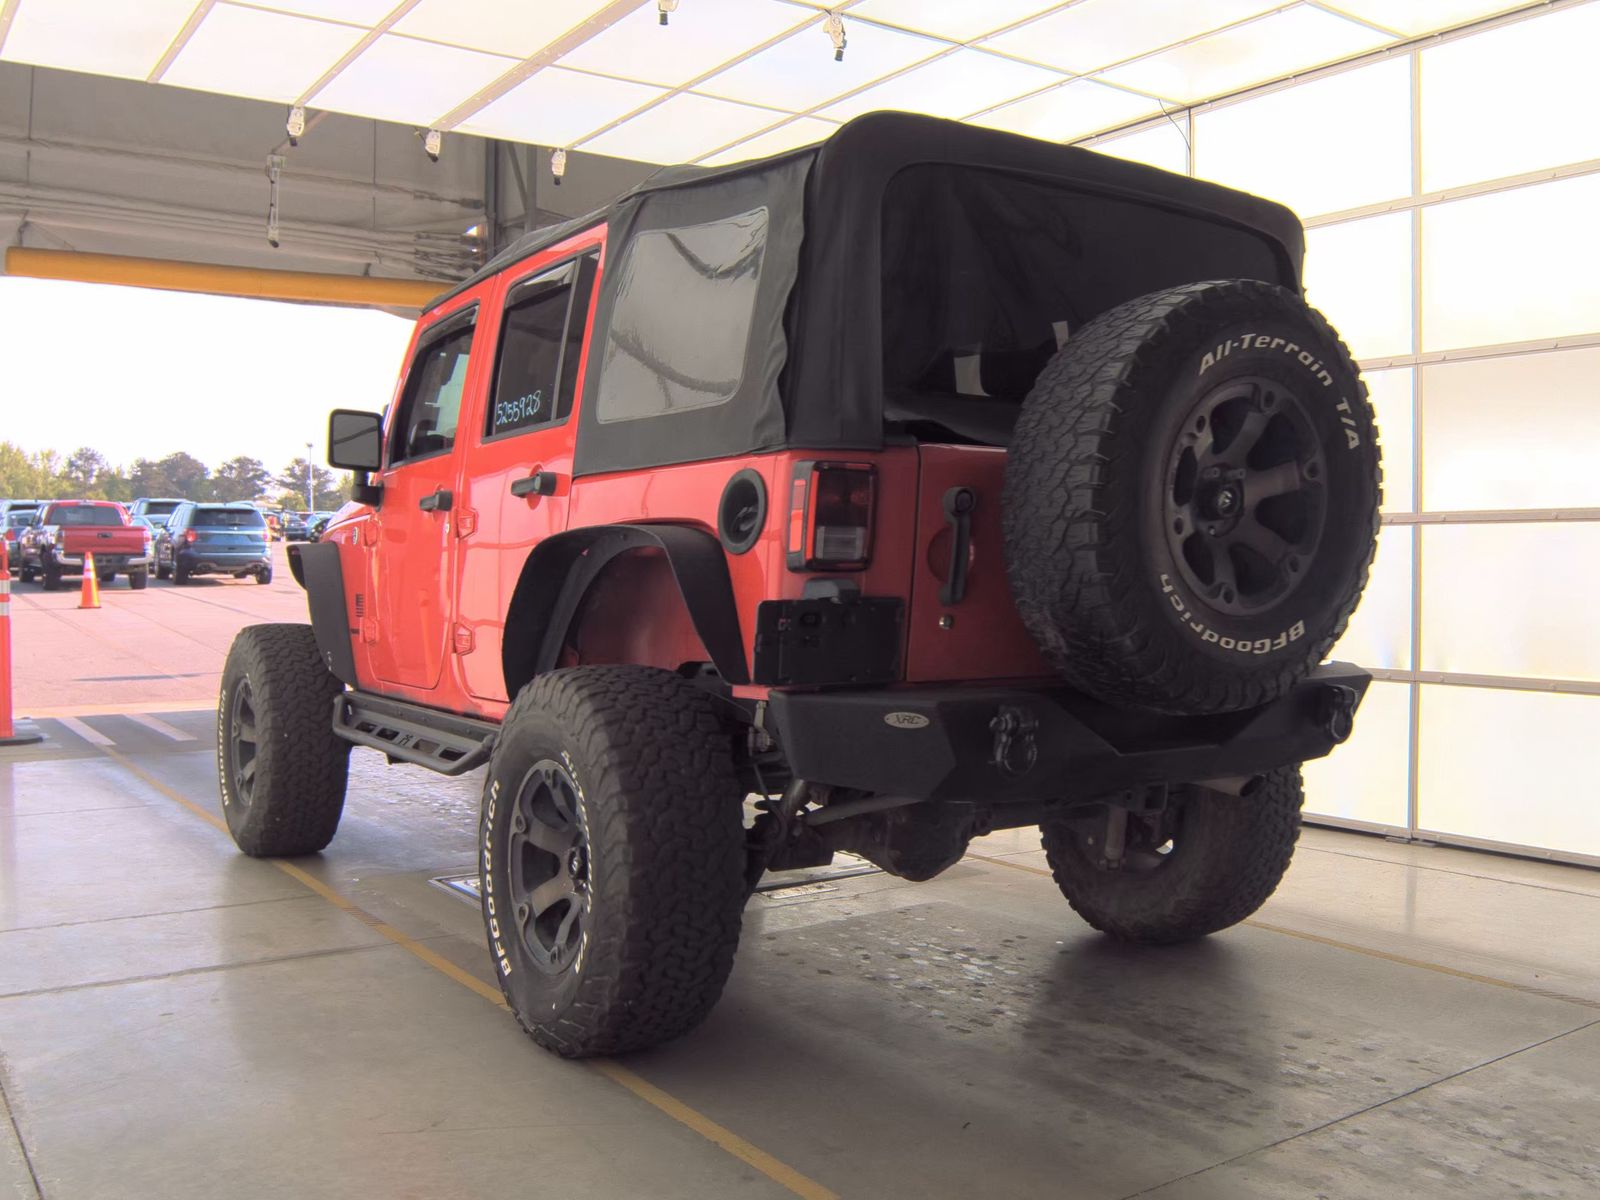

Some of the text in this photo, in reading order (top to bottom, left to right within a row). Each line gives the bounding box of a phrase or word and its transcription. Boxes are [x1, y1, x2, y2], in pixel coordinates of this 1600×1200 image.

[496, 389, 541, 425] 5255928
[1199, 325, 1360, 449] All-Terrain T/A
[1160, 574, 1305, 654] BFGoodrich
[484, 779, 513, 977] BFGoodrich
